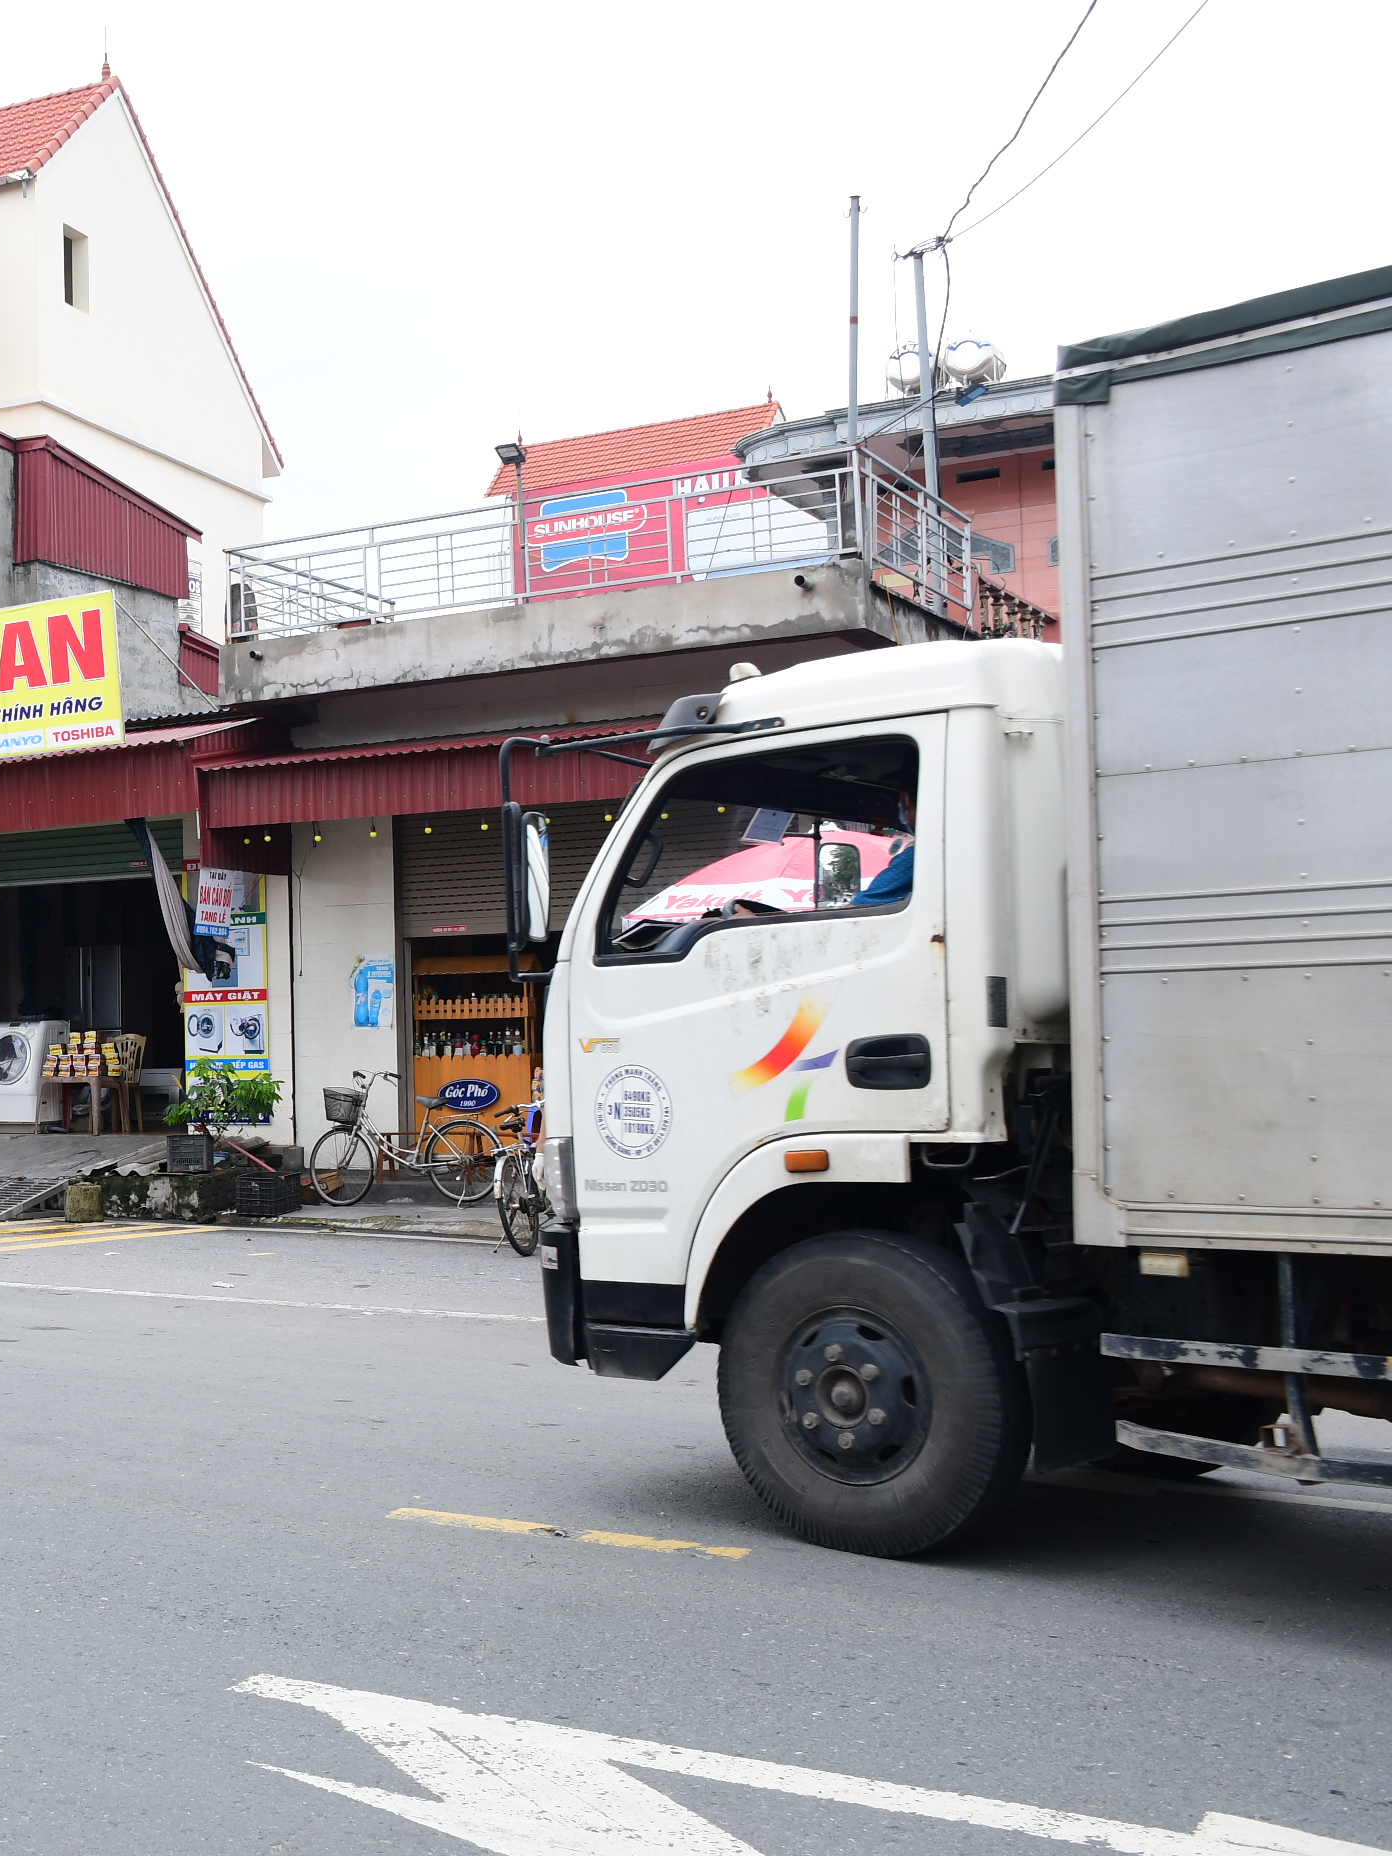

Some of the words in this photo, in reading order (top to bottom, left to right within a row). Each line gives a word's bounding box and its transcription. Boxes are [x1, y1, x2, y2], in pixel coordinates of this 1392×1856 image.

[534, 509, 634, 538] SUNHOUSE
[49, 695, 103, 715] HÃNG
[52, 725, 115, 743] TOSHIBA
[199, 882, 211, 905] BÁN
[201, 910, 217, 923] TANG
[191, 990, 223, 1001] MÁY
[227, 991, 260, 1002] GIẶT
[445, 1085, 465, 1099] Góc
[466, 1083, 489, 1097] Phố
[585, 1179, 626, 1191] Nissan
[630, 1180, 668, 1192] ZD30
